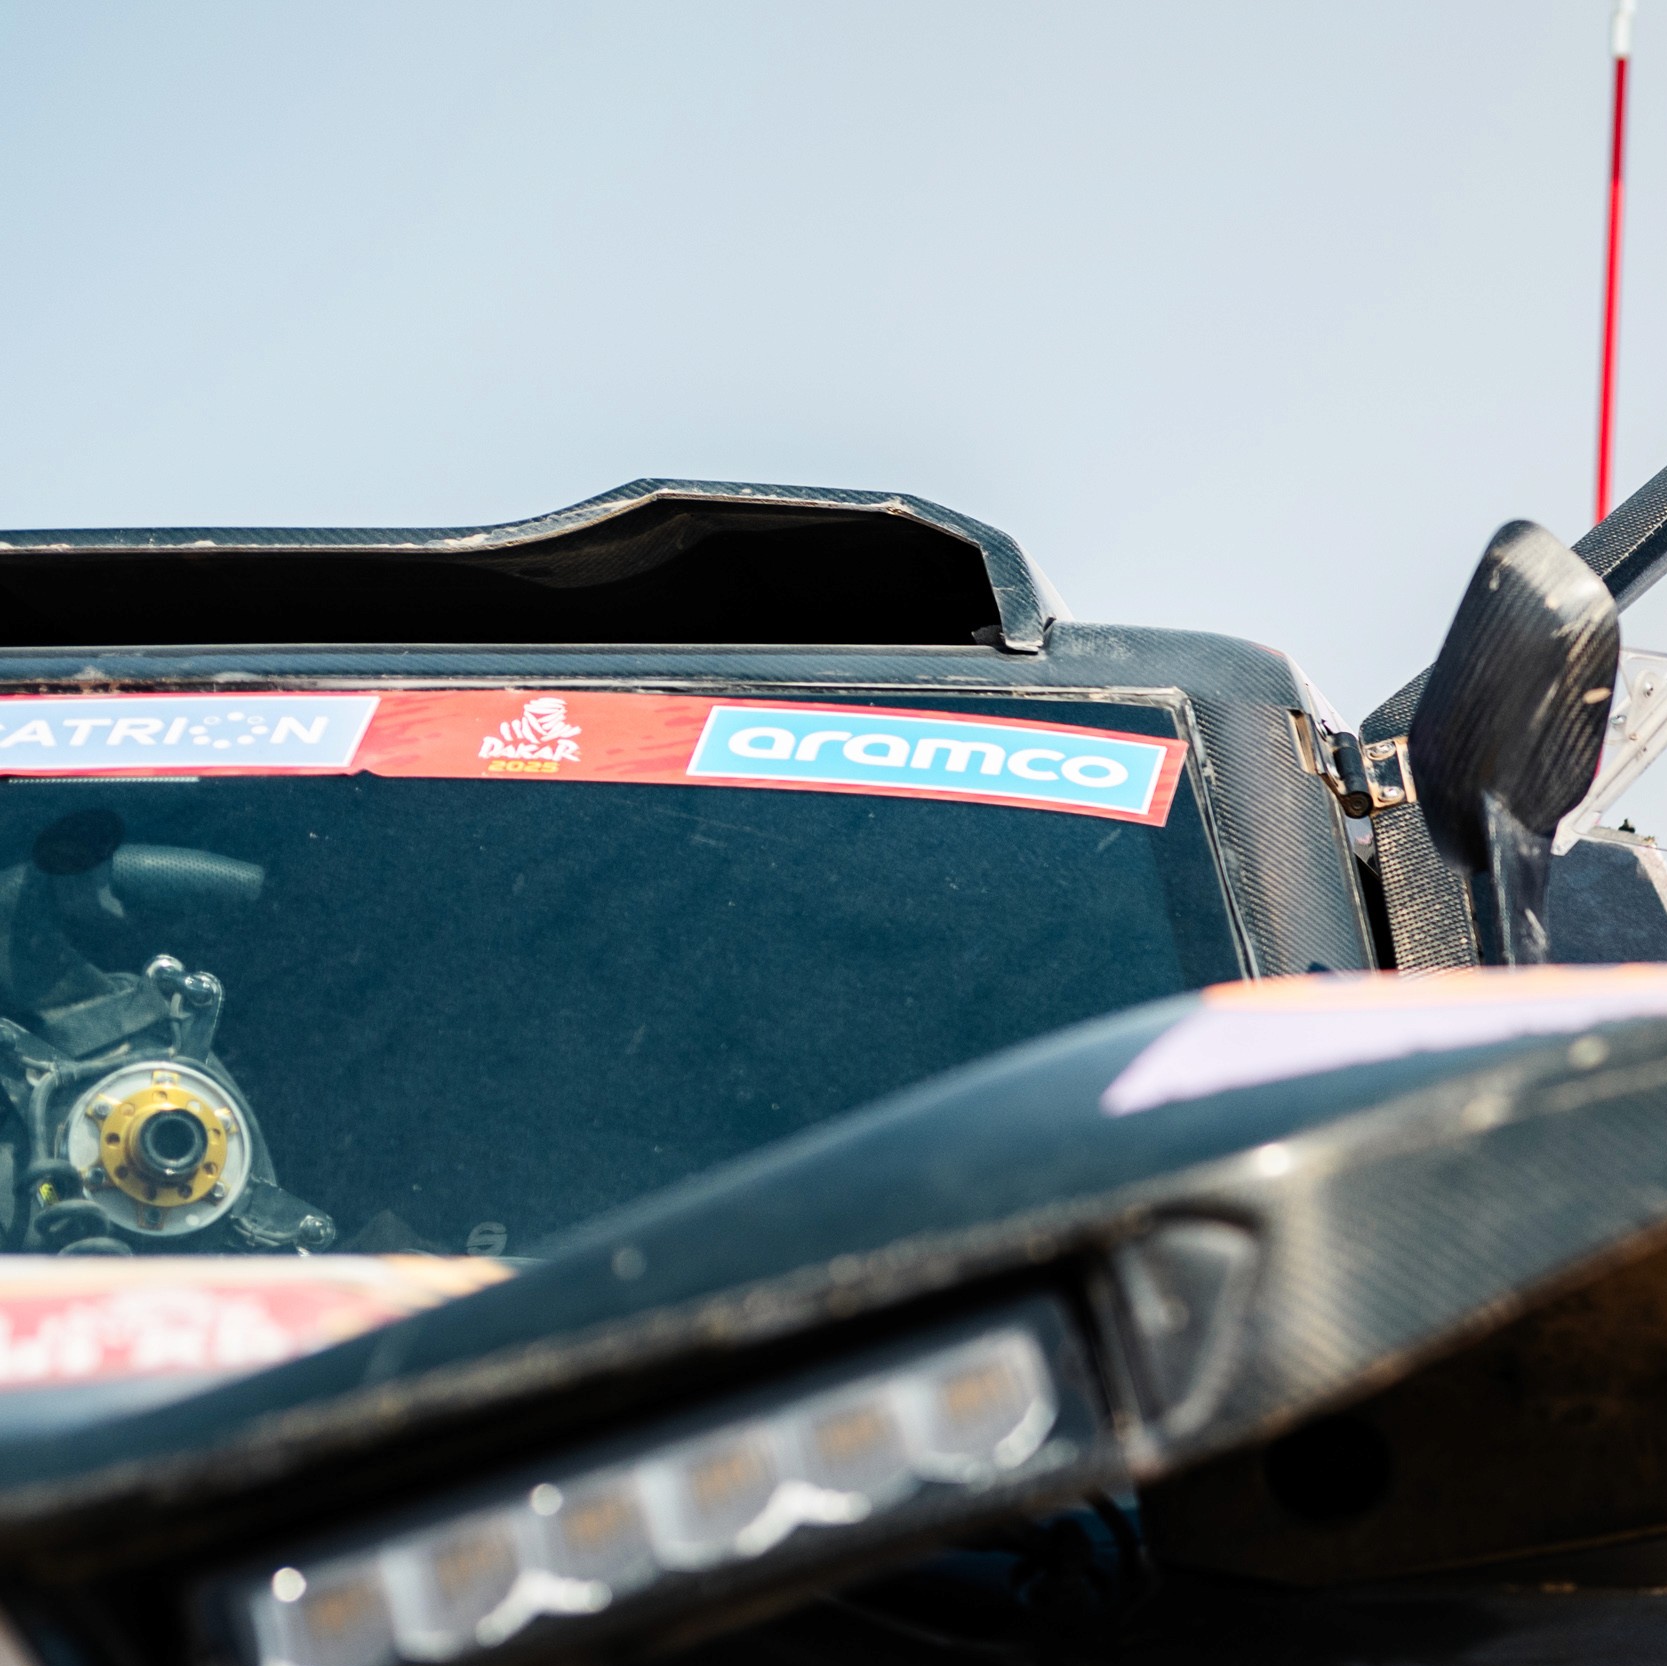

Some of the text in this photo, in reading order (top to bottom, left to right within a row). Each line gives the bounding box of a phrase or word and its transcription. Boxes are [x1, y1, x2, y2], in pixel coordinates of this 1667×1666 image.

[0, 712, 330, 750] ATRION
[488, 759, 560, 774] 2025
[728, 726, 1130, 789] aramco
